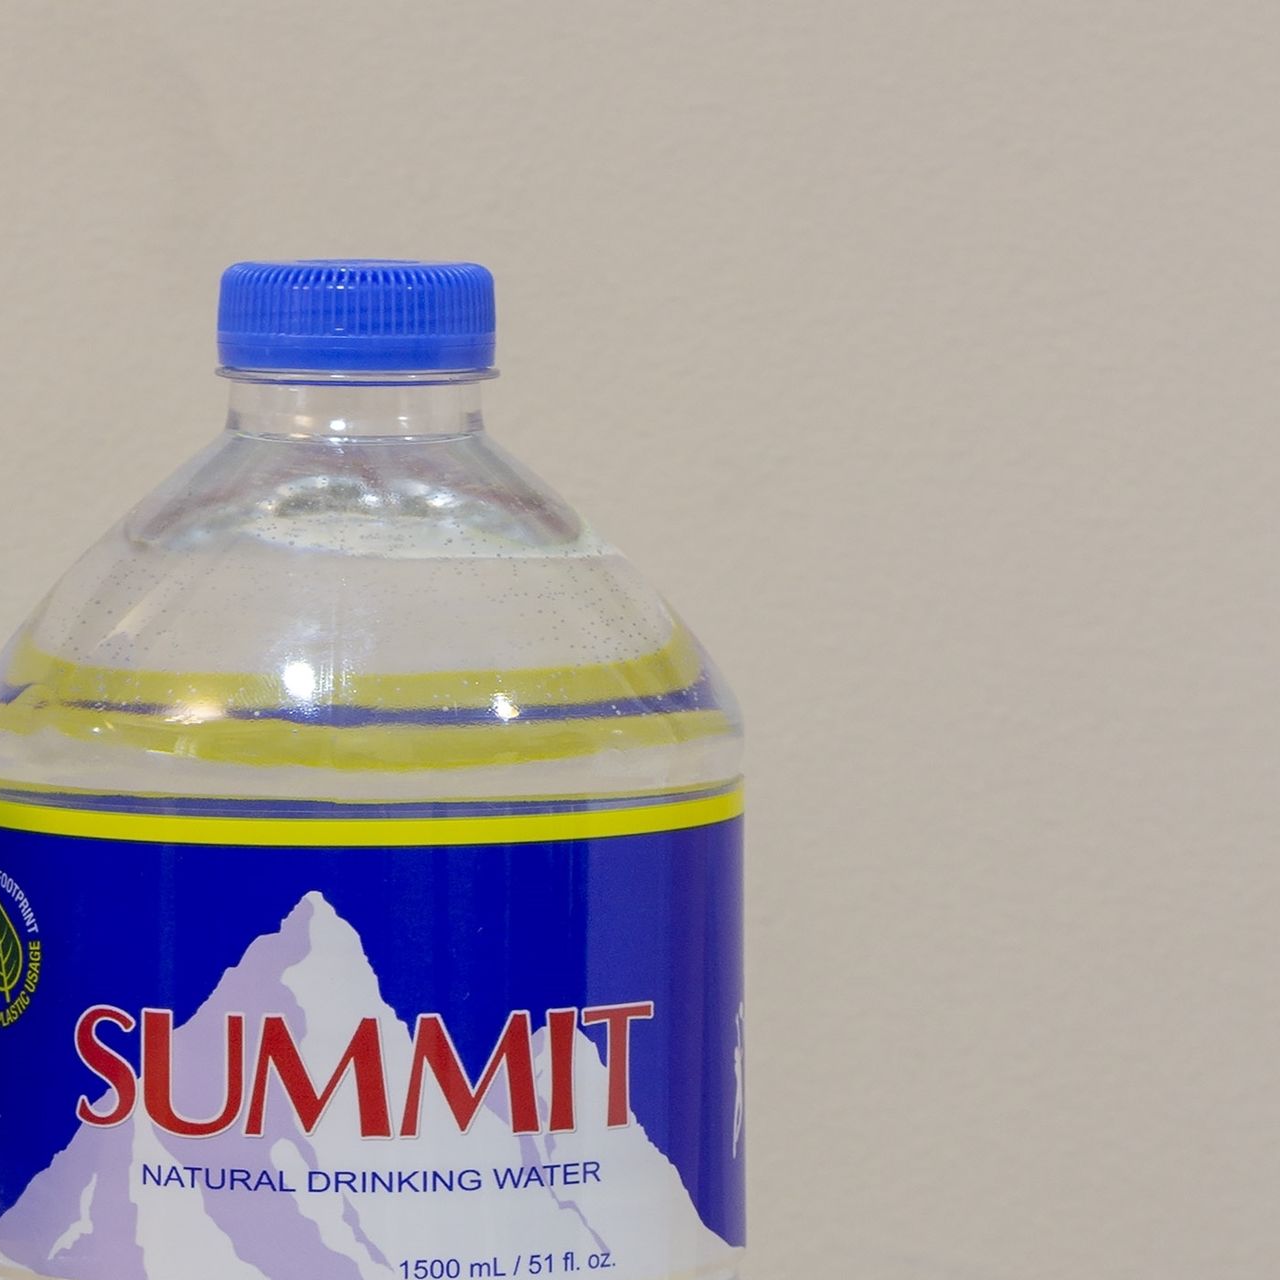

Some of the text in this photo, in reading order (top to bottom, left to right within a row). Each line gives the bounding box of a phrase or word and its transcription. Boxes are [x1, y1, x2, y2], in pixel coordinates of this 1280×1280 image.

[24, 941, 41, 993] USAGE
[74, 1000, 655, 1141] SUMMIT
[141, 1161, 602, 1194] NATURAL DRINKING WATER
[398, 1258, 460, 1280] 1500
[469, 1256, 506, 1278] mL
[528, 1254, 555, 1275] 51
[562, 1251, 581, 1272] fl.
[587, 1252, 616, 1269] oz.
